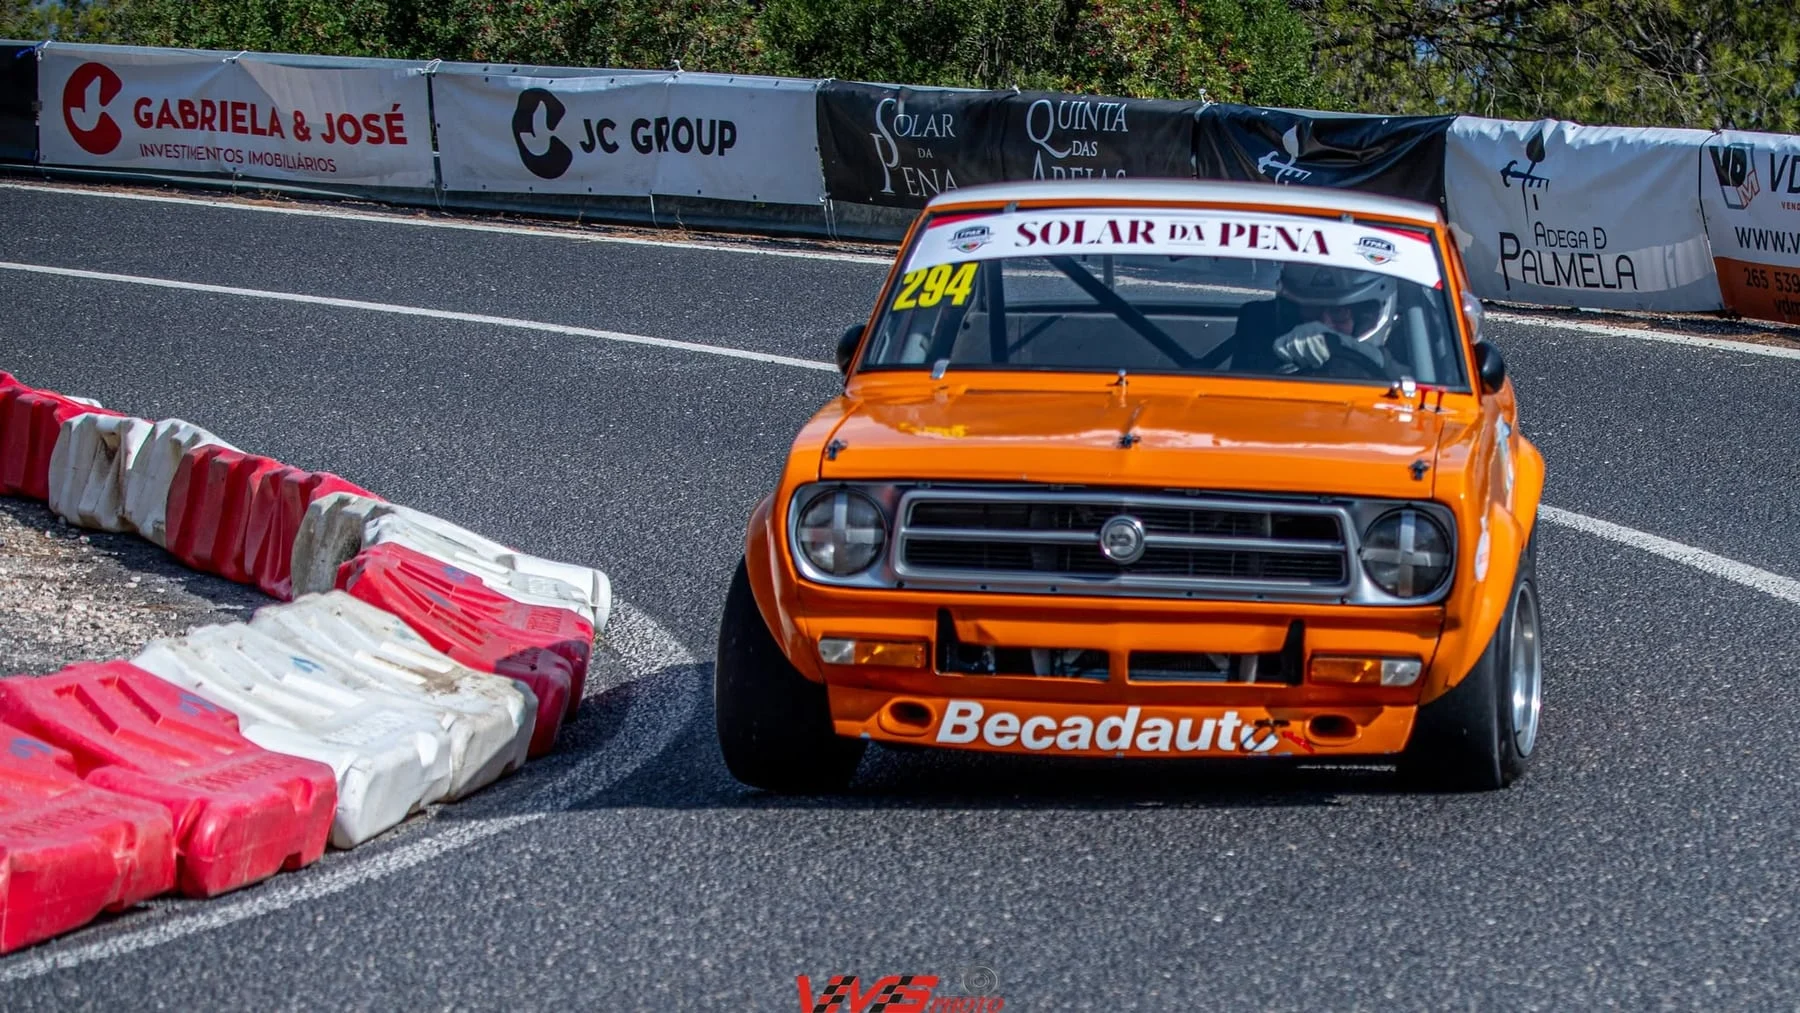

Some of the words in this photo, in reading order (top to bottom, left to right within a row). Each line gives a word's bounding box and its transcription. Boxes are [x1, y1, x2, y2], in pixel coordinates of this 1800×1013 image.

[134, 97, 285, 139] GABRIELA
[293, 110, 312, 143] &
[321, 104, 408, 145] JOSÉ
[579, 118, 619, 154] JC
[631, 117, 737, 156] GROUP
[875, 98, 956, 168] SOLAR
[1026, 99, 1129, 159] QUINTA
[140, 143, 243, 164] INVESTIMENTOS
[248, 152, 337, 172] IMOBILIÁRIOS
[869, 133, 960, 197] PENA
[917, 147, 934, 159] DA
[1072, 141, 1098, 157] DAS
[1015, 220, 1155, 247] SOLAR
[1169, 224, 1205, 241] DA
[1219, 222, 1330, 256] PENA
[1534, 221, 1588, 249] ADEGA
[1499, 231, 1638, 291] PALMELA
[1743, 267, 1769, 290] 265
[1774, 271, 1800, 295] 539
[892, 262, 978, 311] 294
[936, 700, 1279, 753] Becadauto
